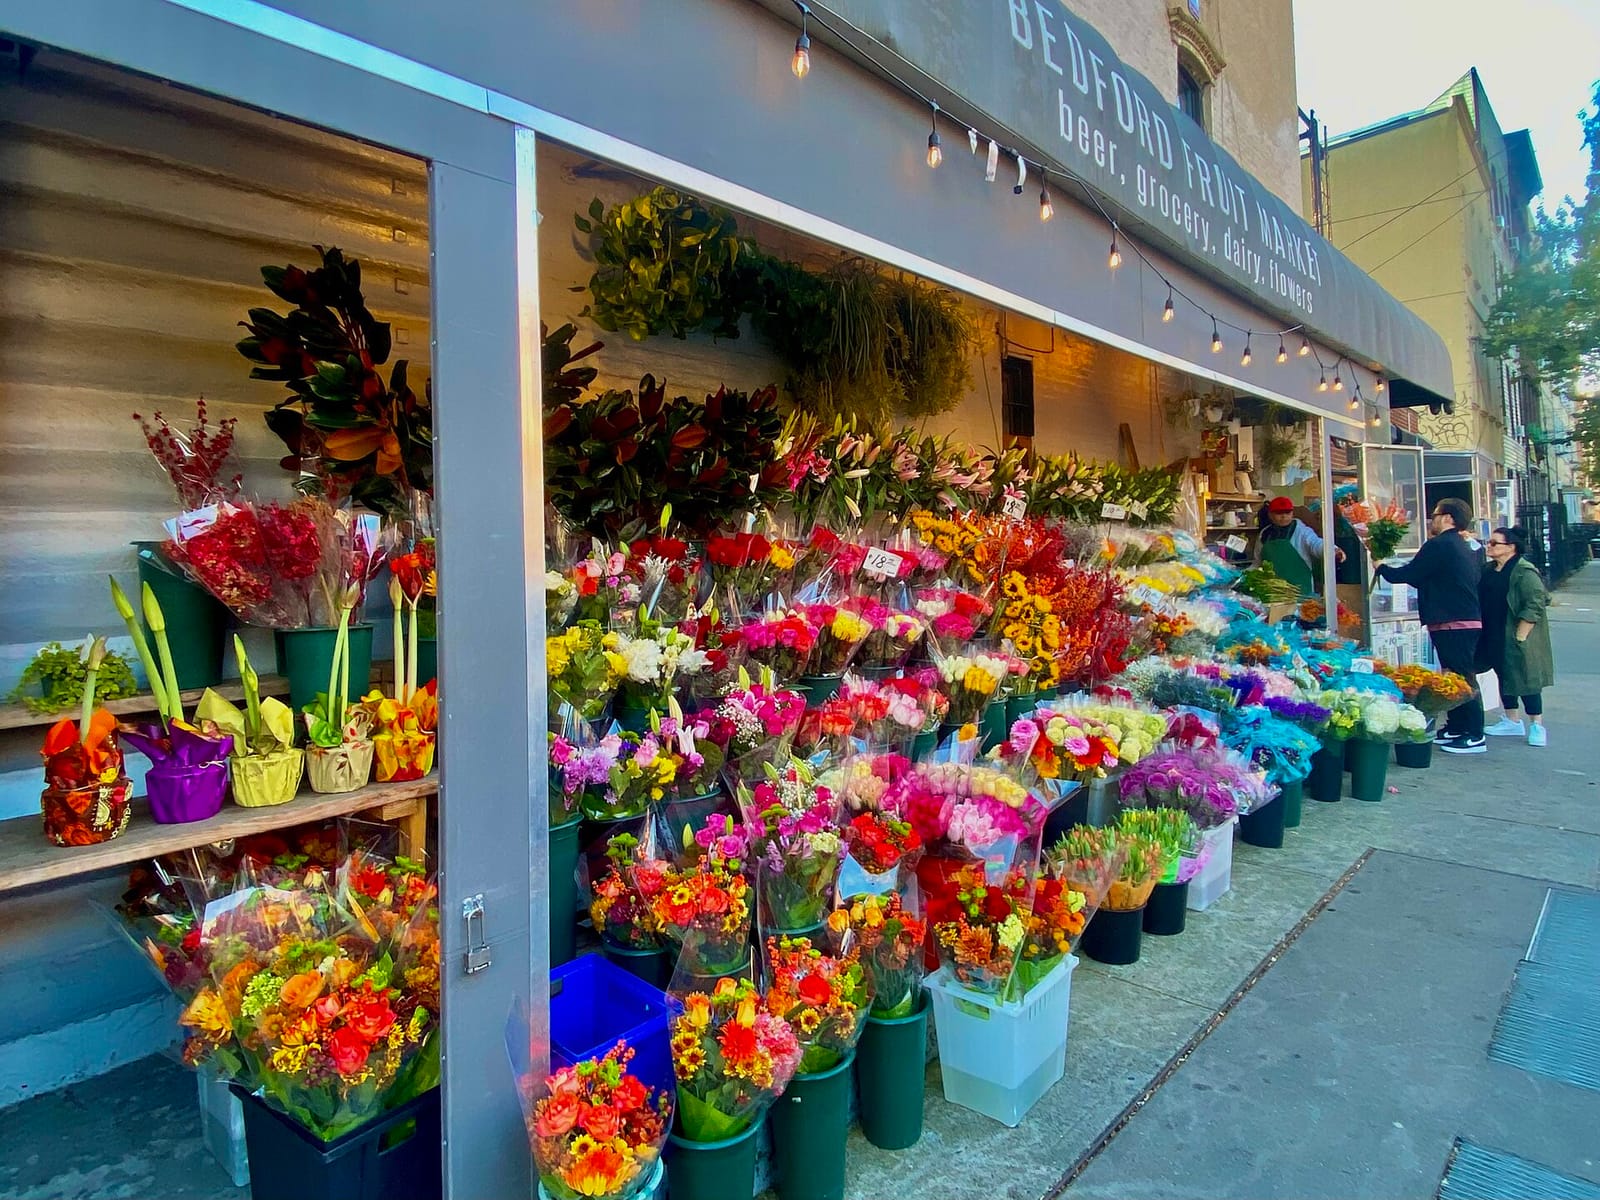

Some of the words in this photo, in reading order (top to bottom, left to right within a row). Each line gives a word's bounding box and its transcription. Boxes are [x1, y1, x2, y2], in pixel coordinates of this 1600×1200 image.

[1008, 0, 1173, 170] BEDFORD
[1181, 137, 1249, 231] FRUIT
[1256, 200, 1321, 287] MARKET
[1058, 88, 1125, 185] beer,
[1137, 164, 1216, 254] grocery,
[1224, 226, 1265, 284] dairy,
[1269, 259, 1313, 314] flowers
